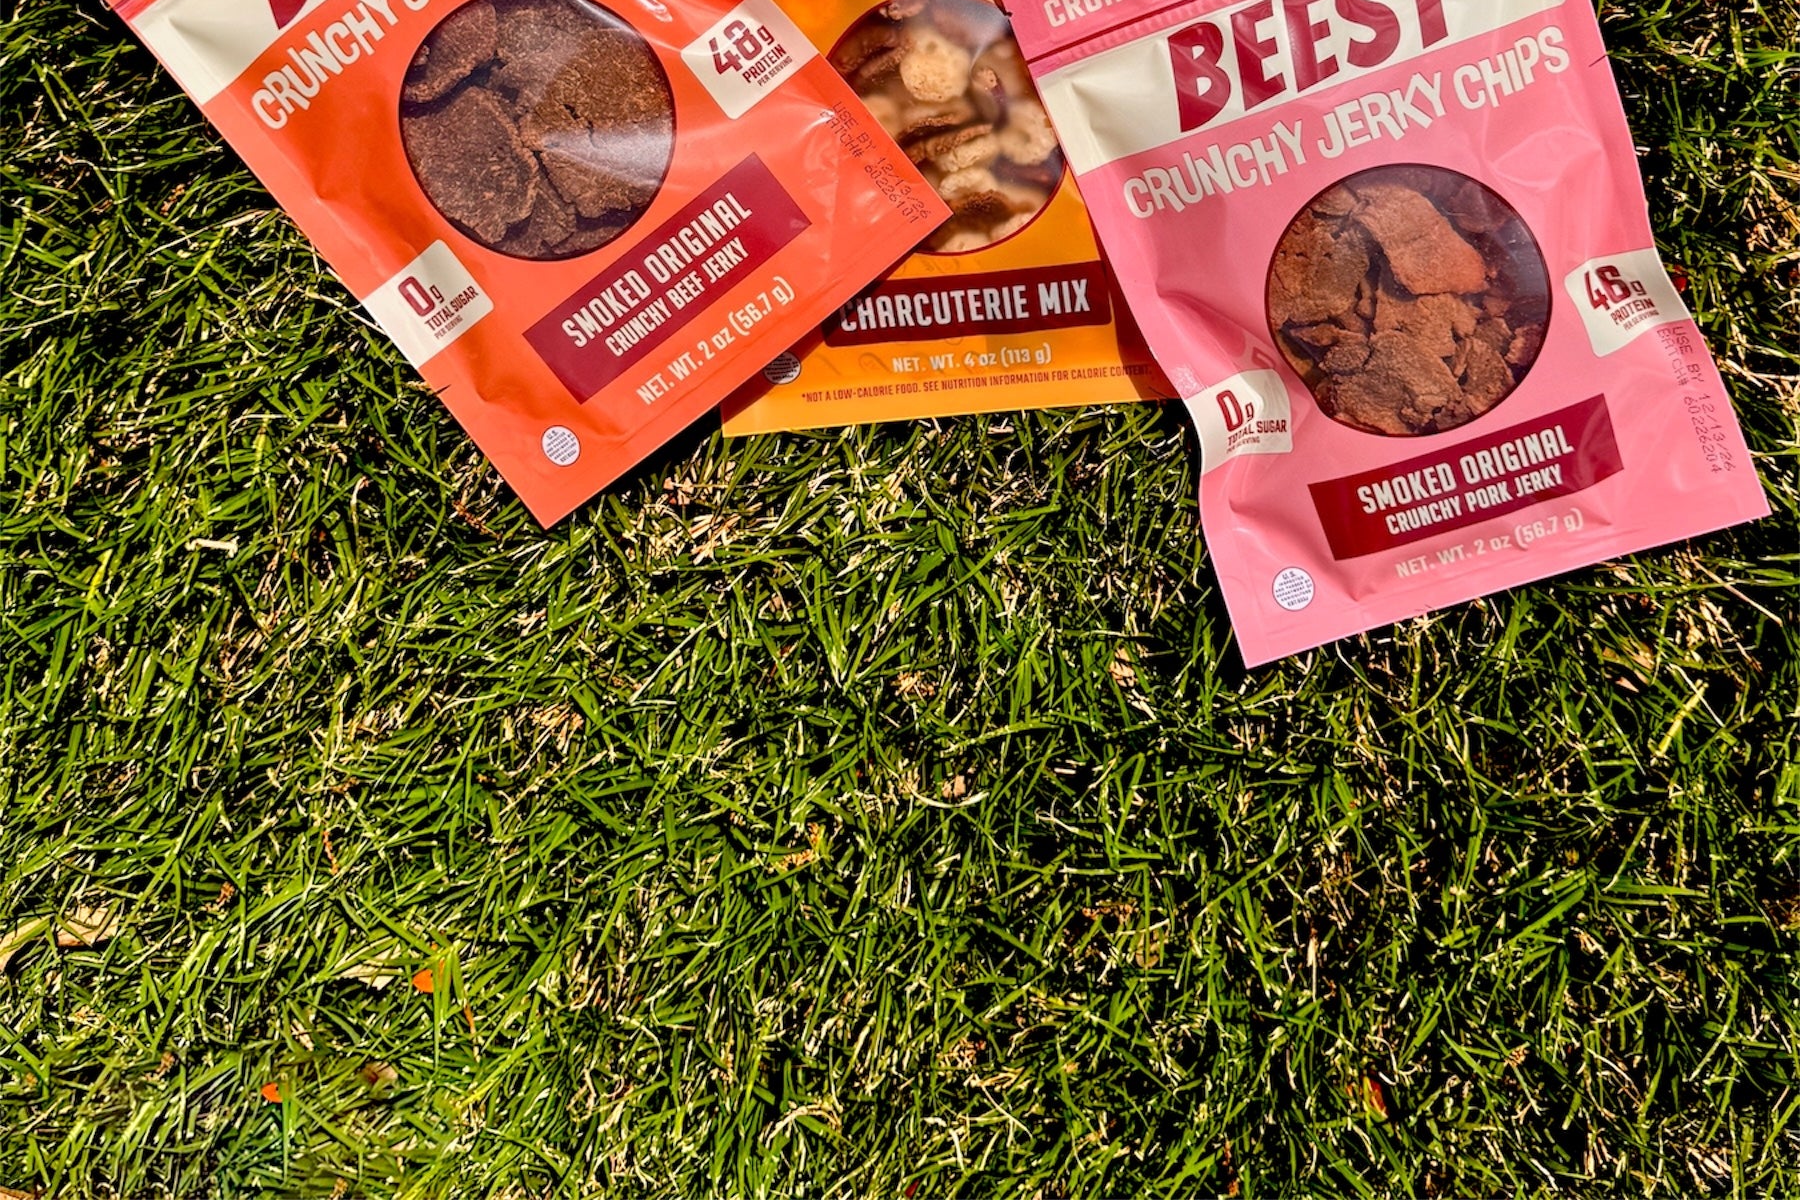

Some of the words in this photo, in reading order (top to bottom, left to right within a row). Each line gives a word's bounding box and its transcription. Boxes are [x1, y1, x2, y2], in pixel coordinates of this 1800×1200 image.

[742, 44, 786, 84] PROTEIN
[757, 73, 770, 87] PER
[1123, 120, 1307, 219] CRUNCHY
[1317, 71, 1446, 159] JERKY
[1453, 26, 1570, 111] CHIPS
[832, 101, 859, 130] USE
[856, 132, 876, 150] BY
[877, 157, 931, 219] 12/13/26
[561, 270, 651, 348] SMOKED
[643, 192, 752, 284] ORIGINAL
[604, 298, 672, 357] CRUNCHY
[665, 271, 705, 310] BEEF
[701, 236, 749, 283] JERKY
[840, 285, 1029, 332] CHARCUTERIE
[1037, 278, 1090, 316] MIX
[424, 306, 455, 331] TOTAL
[450, 285, 479, 312] SUGAR
[636, 374, 675, 405] NET.
[667, 352, 703, 382] WT.
[697, 341, 715, 361] 2
[712, 327, 736, 351] oz
[728, 292, 774, 336] (56.7
[772, 275, 795, 306] g)
[1611, 298, 1655, 325] PROTEIN
[825, 391, 831, 401] A
[833, 385, 894, 400] LOW-CALORIE
[895, 382, 921, 394] FOOD.
[923, 380, 939, 392] SEE
[941, 376, 987, 390] NUTRITION
[990, 371, 1049, 387] INFORMATION
[1051, 370, 1068, 382] FOR
[1071, 366, 1107, 381] CALORIE
[892, 356, 926, 374] NET.
[930, 353, 960, 371] WT.
[963, 353, 975, 367] 4
[977, 352, 997, 366] oz
[1001, 347, 1031, 367] (113
[1034, 345, 1052, 366] g)
[1228, 424, 1254, 446] TOTAL
[1256, 419, 1287, 433] SUGAR
[1657, 328, 1688, 386] BATCH#
[1684, 396, 1722, 473] 60226204
[1672, 326, 1693, 355] USE
[1686, 362, 1704, 383] BY
[1699, 393, 1736, 472] 12/13/26
[1357, 462, 1457, 514] SMOKED
[1459, 424, 1574, 485] ORIGINAL
[1385, 495, 1463, 535] CRUNCHY
[1465, 483, 1512, 513] PORK
[1514, 463, 1563, 498] JERKY
[1395, 557, 1436, 579] NET.
[1439, 545, 1472, 567] WT.
[1474, 538, 1486, 557] 2
[1489, 535, 1511, 553] oz
[1514, 516, 1558, 548] (56.7
[1564, 508, 1584, 533] g)
